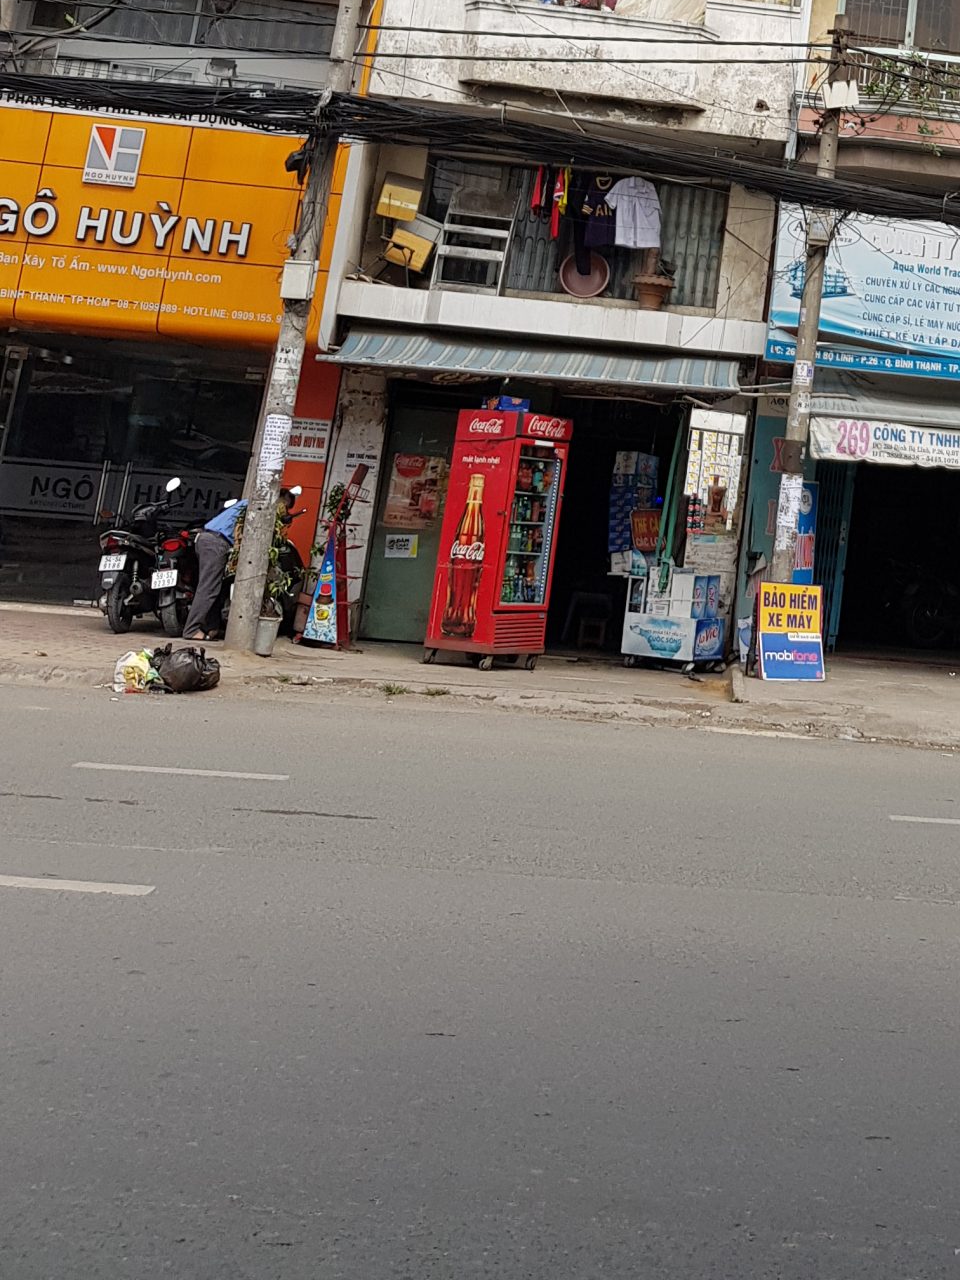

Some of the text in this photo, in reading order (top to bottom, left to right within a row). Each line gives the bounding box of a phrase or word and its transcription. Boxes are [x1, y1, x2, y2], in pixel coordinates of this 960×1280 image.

[76, 201, 253, 258] HUỲNH
[23, 253, 45, 269] Xây
[51, 254, 66, 269] Tổ
[69, 255, 90, 271] Ấm
[893, 261, 915, 273] Aqua
[917, 263, 941, 276] World
[865, 276, 898, 289] CHUYÊN
[86, 296, 110, 308] HCM
[864, 293, 886, 305] CUNG
[862, 311, 883, 323] CUNG
[895, 356, 914, 369] BÌNH
[916, 361, 942, 373] THẠNH
[469, 418, 504, 434] Coca-Cola
[836, 420, 870, 457] 269
[873, 423, 907, 443] CÔNG
[910, 430, 925, 445] TY
[929, 432, 960, 448] TNHH
[30, 474, 96, 502] NGÔ
[450, 540, 485, 561] Coca-Cola
[763, 586, 818, 611] BẢO HIỂM
[768, 611, 813, 629] XE MÁY
[765, 649, 818, 661] mobifone
